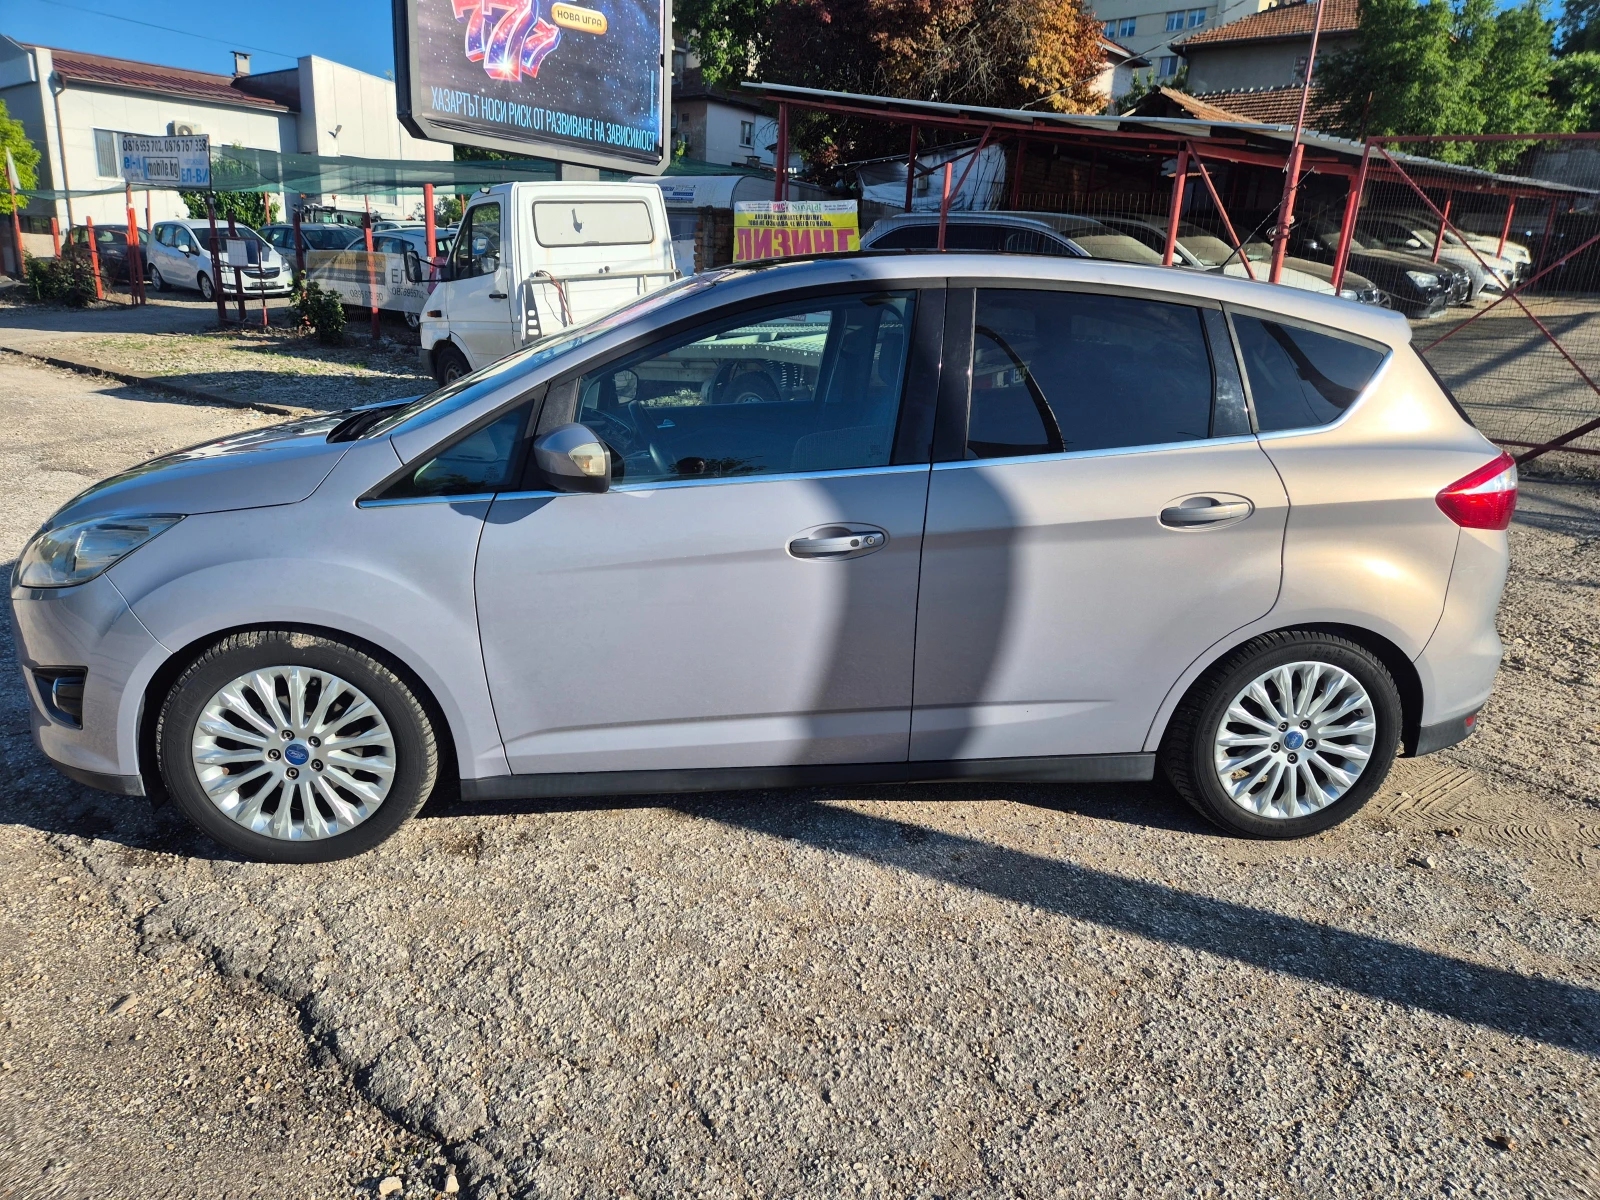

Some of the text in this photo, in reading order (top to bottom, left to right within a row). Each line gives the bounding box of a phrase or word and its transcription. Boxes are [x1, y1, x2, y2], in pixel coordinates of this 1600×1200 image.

[557, 9, 602, 27] НОВА ИГРА
[430, 85, 655, 152] ХАЗАРТЪТ НОСИ РИСК ОТ РАЗВИВАНЕ НА ЗАВИСИМОСТ
[122, 139, 140, 152] 0876
[164, 139, 181, 152] 0876
[181, 139, 193, 152] 767
[147, 159, 179, 179] mobile.bg
[181, 167, 209, 183] ЕЛ-ВИ
[736, 228, 855, 260] ЛИЗИНГ
